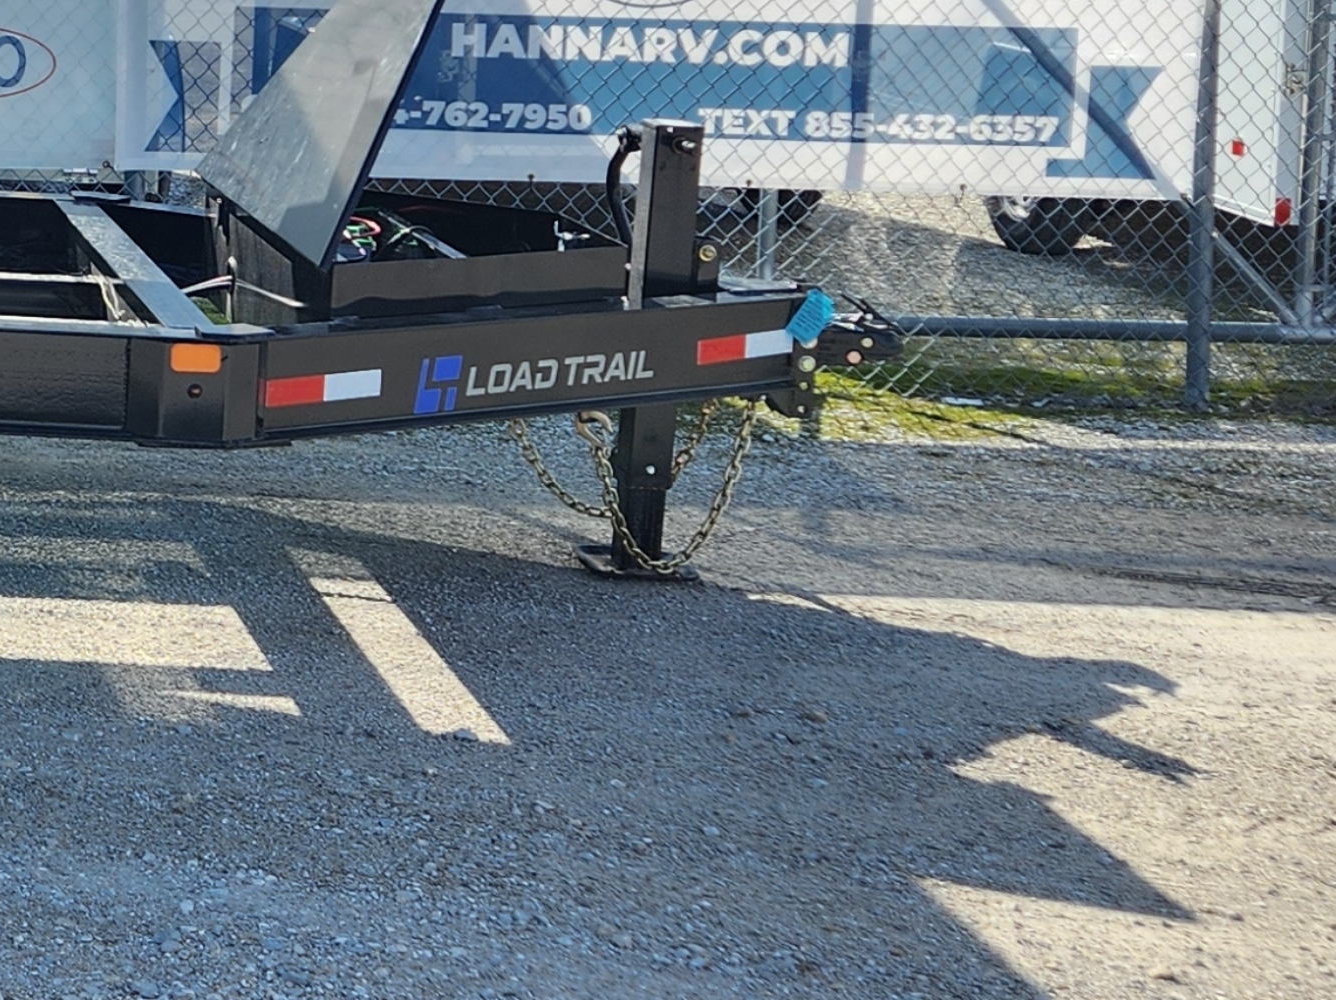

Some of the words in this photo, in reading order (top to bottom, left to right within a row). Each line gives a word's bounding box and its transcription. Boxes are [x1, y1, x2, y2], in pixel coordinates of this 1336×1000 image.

[450, 22, 851, 68] HANNARV.COM
[698, 107, 797, 137] TEXT
[804, 110, 1059, 143] 855-432-6357
[465, 358, 559, 396] LOAD
[564, 350, 654, 386] TRAIL
